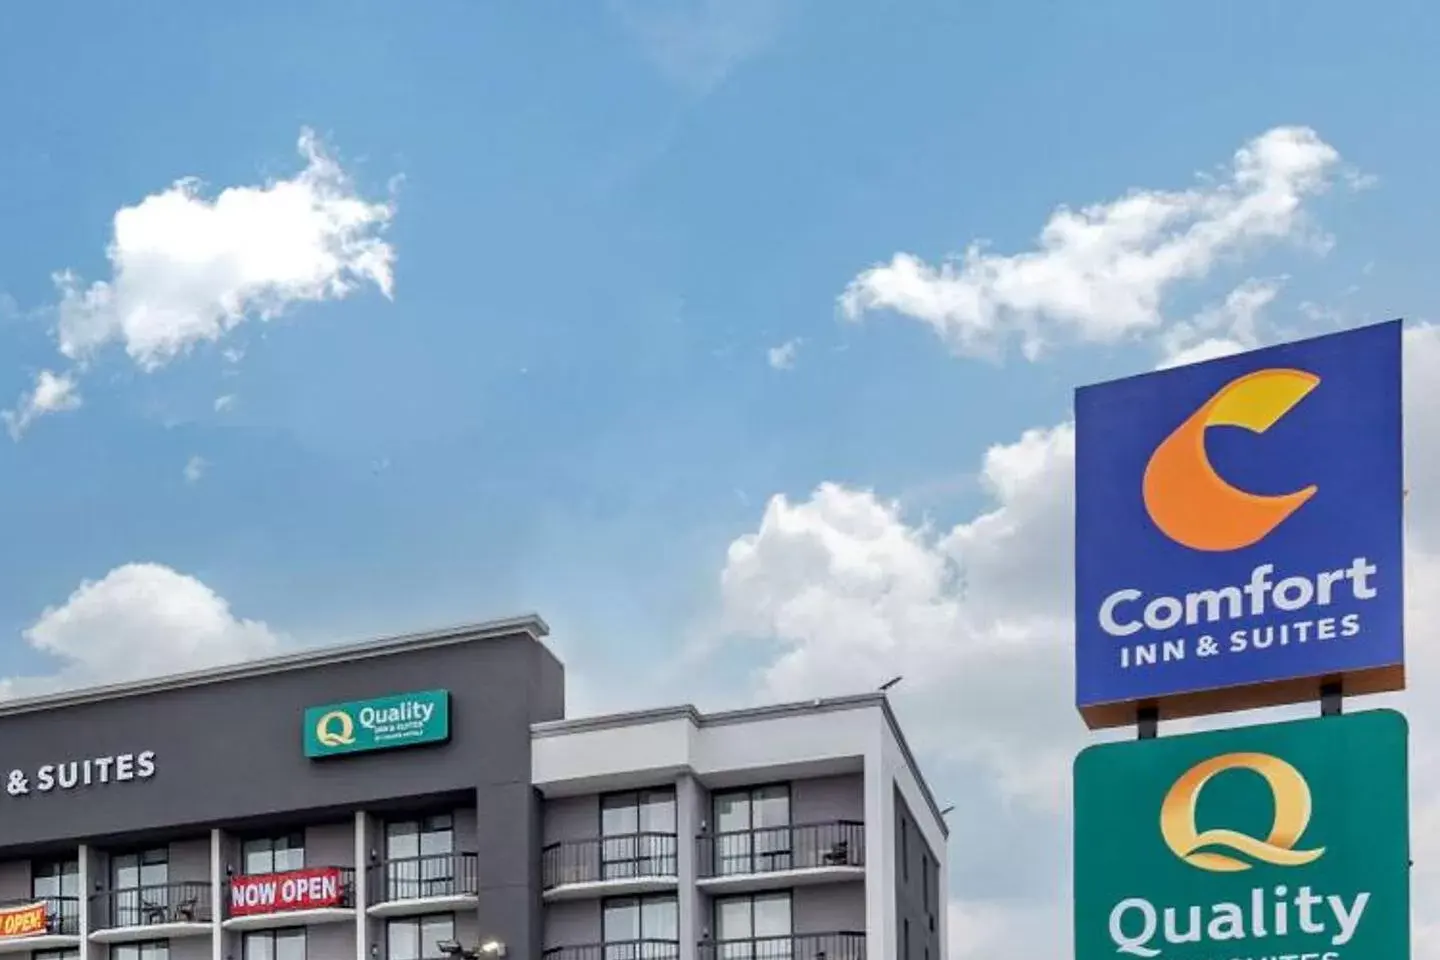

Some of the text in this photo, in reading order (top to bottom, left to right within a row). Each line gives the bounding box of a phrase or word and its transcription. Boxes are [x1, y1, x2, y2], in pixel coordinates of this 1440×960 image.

[1098, 556, 1378, 637] Comfort
[1120, 613, 1360, 668] INN & SUITES
[359, 701, 435, 728] Quality
[6, 768, 29, 796] &
[36, 750, 157, 791] SUITES
[232, 875, 337, 908] NOW OPEN
[1108, 885, 1372, 958] Quality
